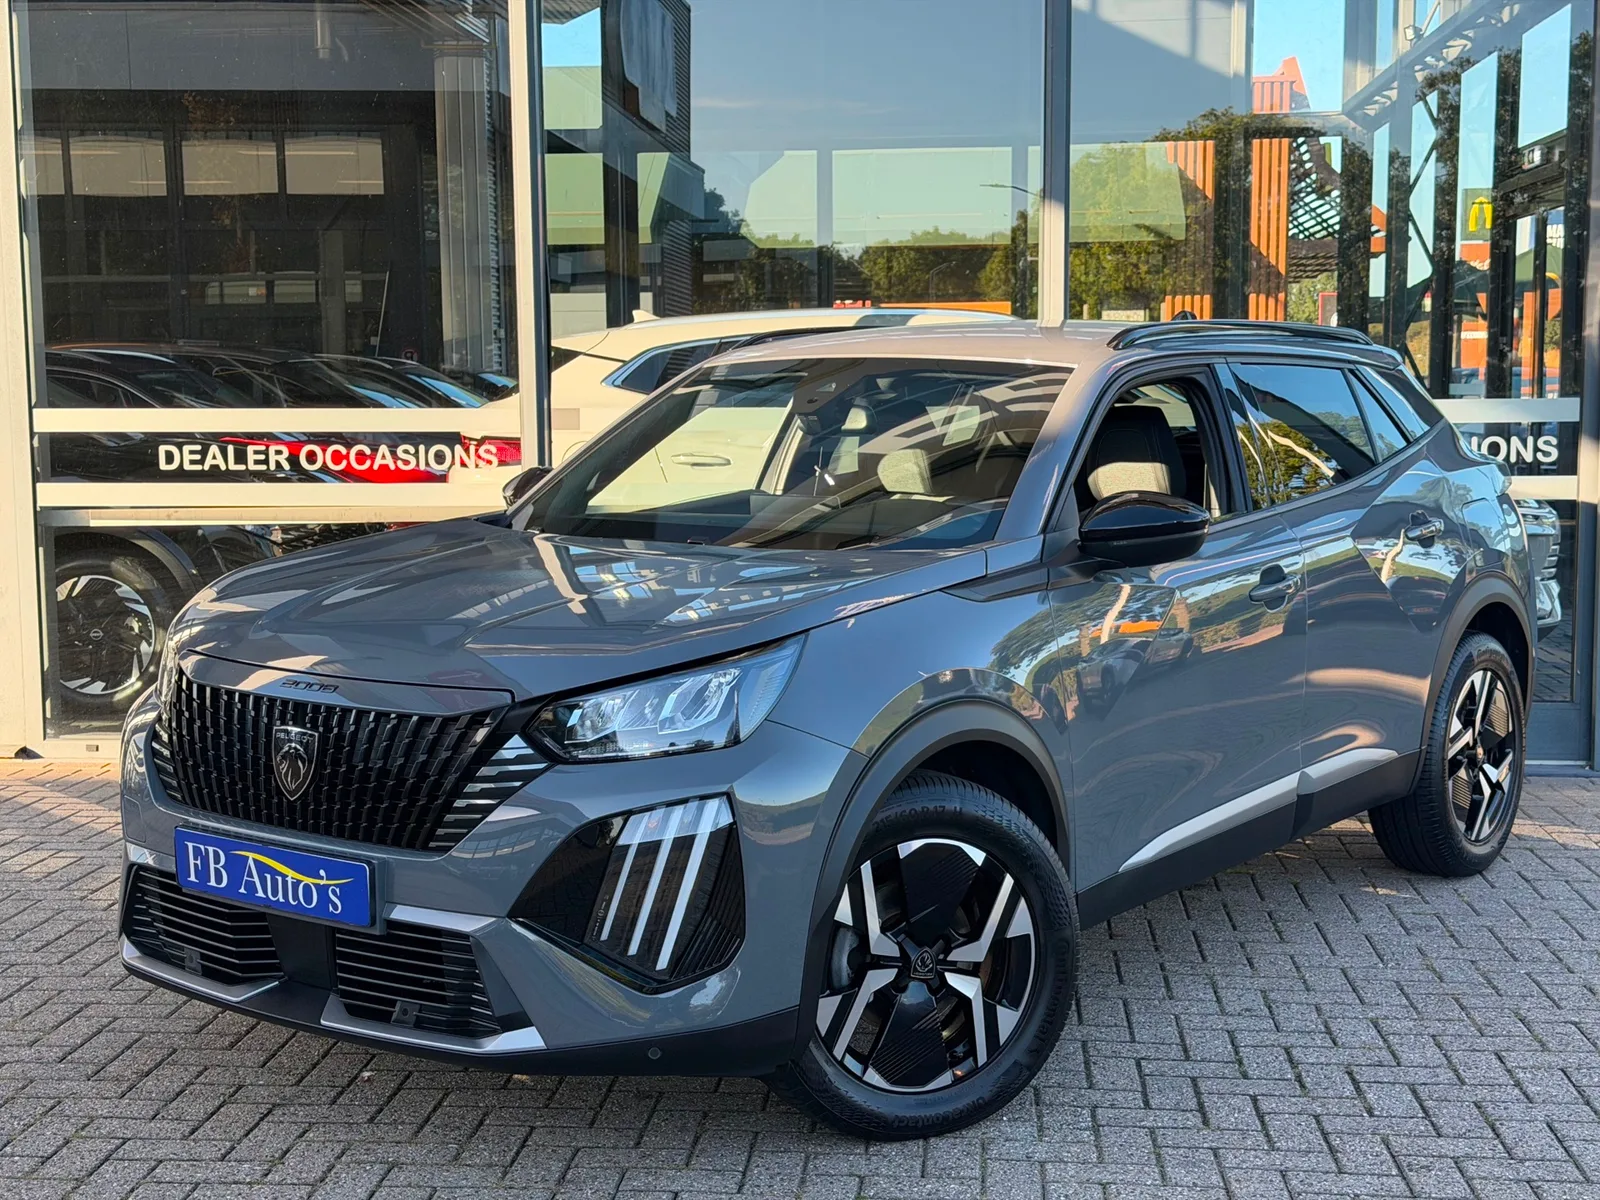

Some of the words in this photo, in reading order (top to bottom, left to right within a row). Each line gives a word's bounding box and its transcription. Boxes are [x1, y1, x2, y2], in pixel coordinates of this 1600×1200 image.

[158, 444, 290, 471] DEALER
[299, 444, 499, 471] OCCASIONS
[280, 679, 339, 694] 2008
[275, 731, 313, 743] PEUGEOT
[184, 841, 228, 888] FB
[238, 855, 342, 914] Auto's
